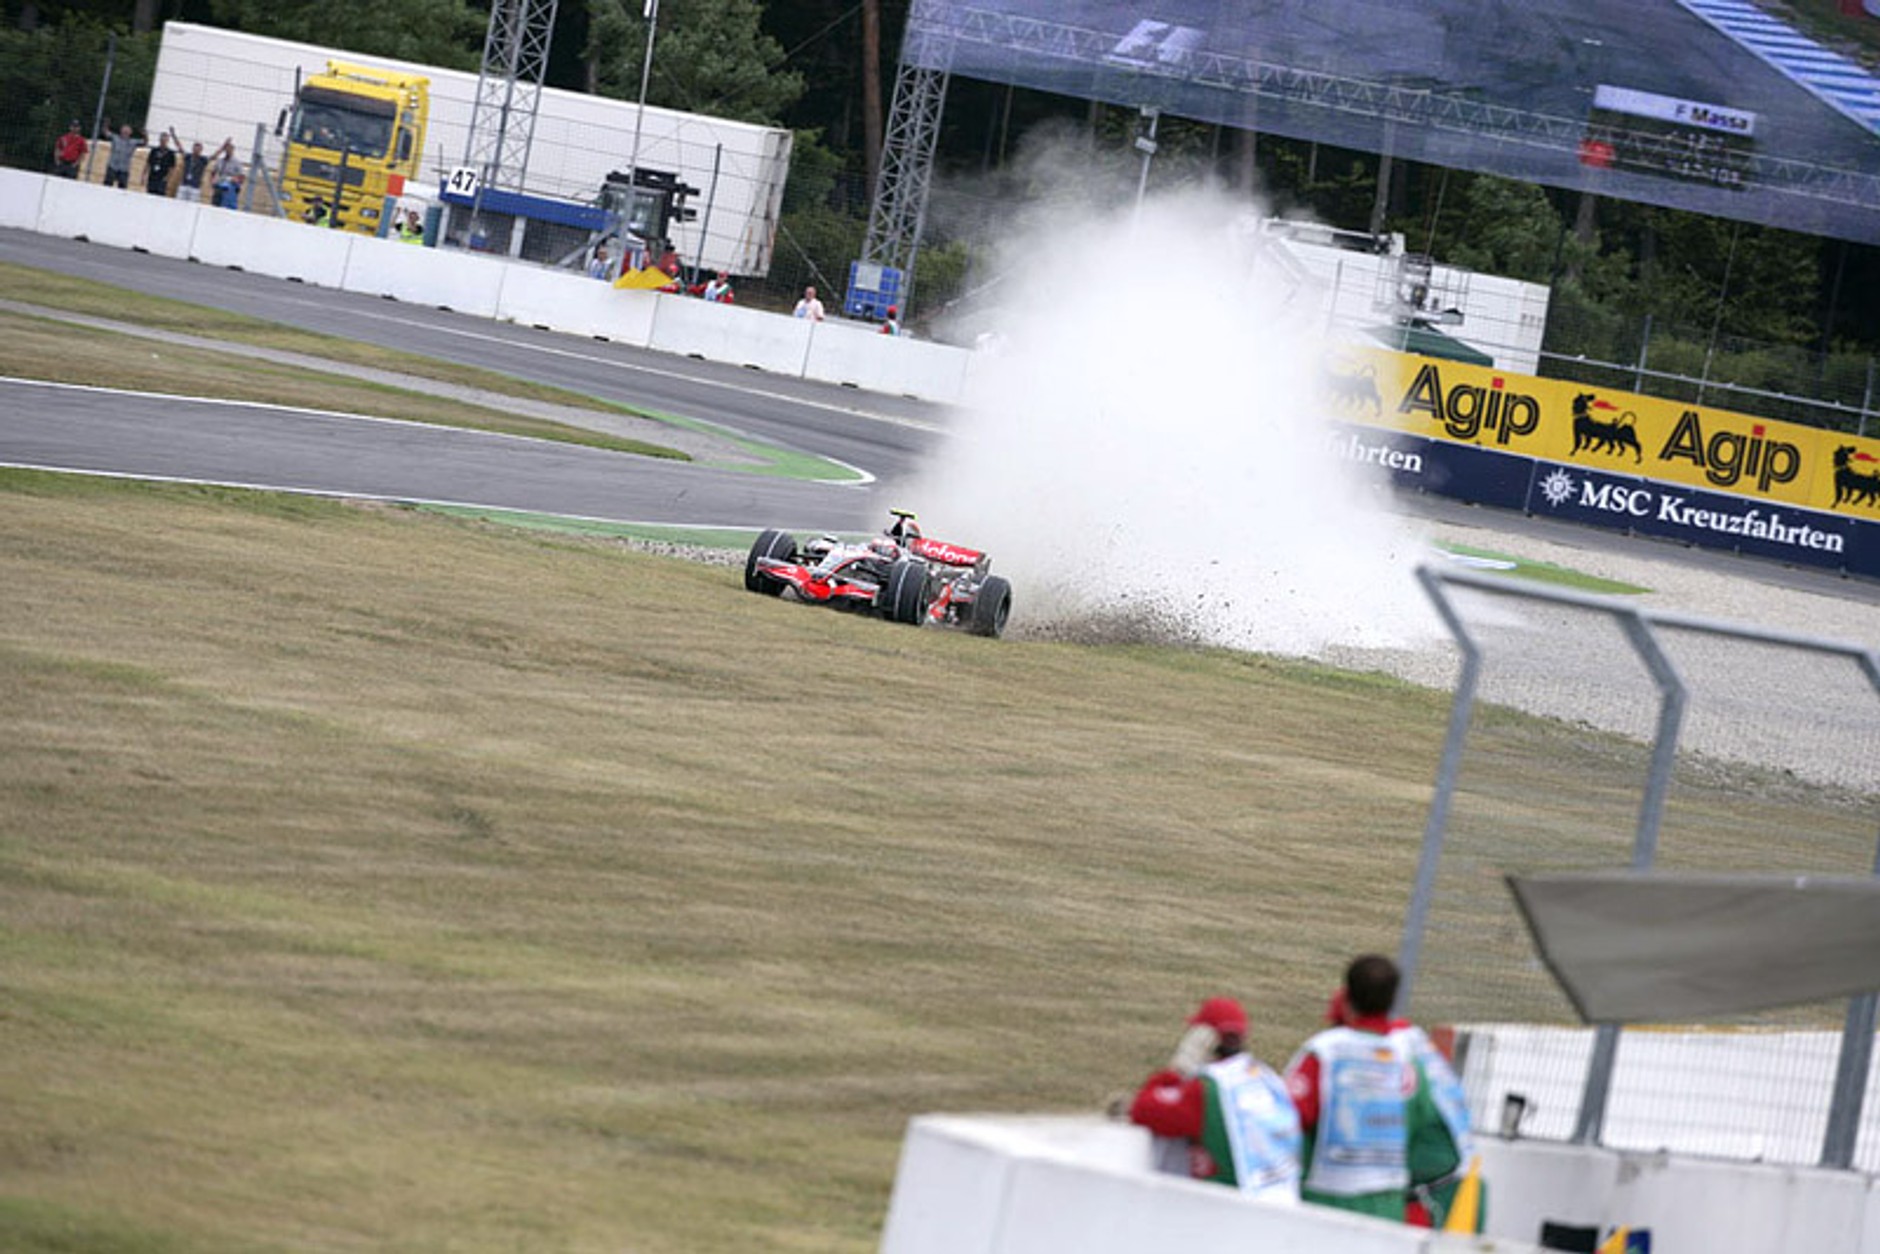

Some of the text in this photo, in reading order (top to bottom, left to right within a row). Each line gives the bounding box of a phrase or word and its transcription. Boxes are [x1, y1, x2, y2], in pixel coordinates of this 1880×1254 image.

[1691, 106, 1748, 130] Massa
[452, 169, 476, 191] 47
[1400, 364, 1540, 444] Agip
[1658, 411, 1801, 492] Agip
[1579, 481, 1844, 553] MSC Kreuzfahrten
